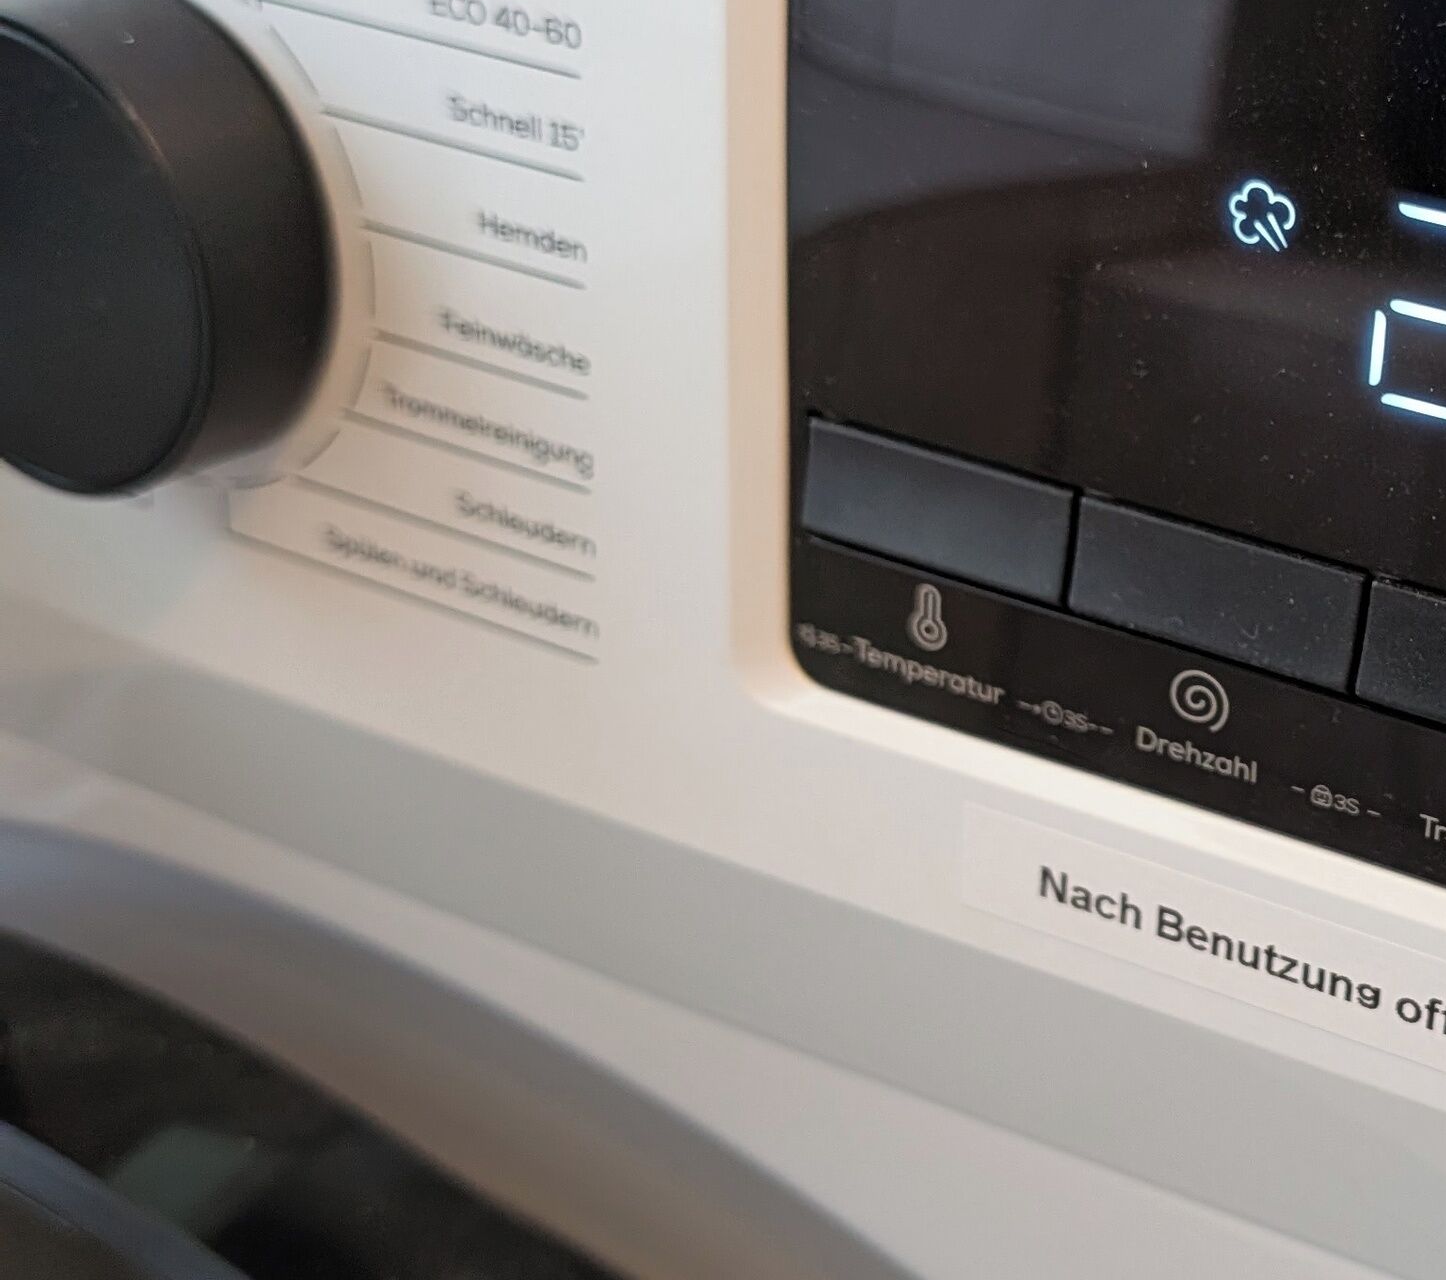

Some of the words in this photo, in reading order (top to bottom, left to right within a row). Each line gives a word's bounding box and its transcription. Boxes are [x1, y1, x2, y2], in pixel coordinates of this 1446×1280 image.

[495, 7, 582, 50] 40-60
[448, 94, 542, 141] Schnell
[477, 210, 588, 263] Hemden
[437, 307, 591, 376] Feinwäsche
[382, 382, 595, 480] Trommelreinigung
[455, 490, 597, 559] Schleudern
[411, 560, 456, 589] und
[459, 571, 599, 640] Schleudern
[853, 635, 1006, 705] Temperatur
[1135, 724, 1259, 785] Drehzahl
[1038, 865, 1142, 930] Nach
[1156, 904, 1381, 1010] Benutzung
